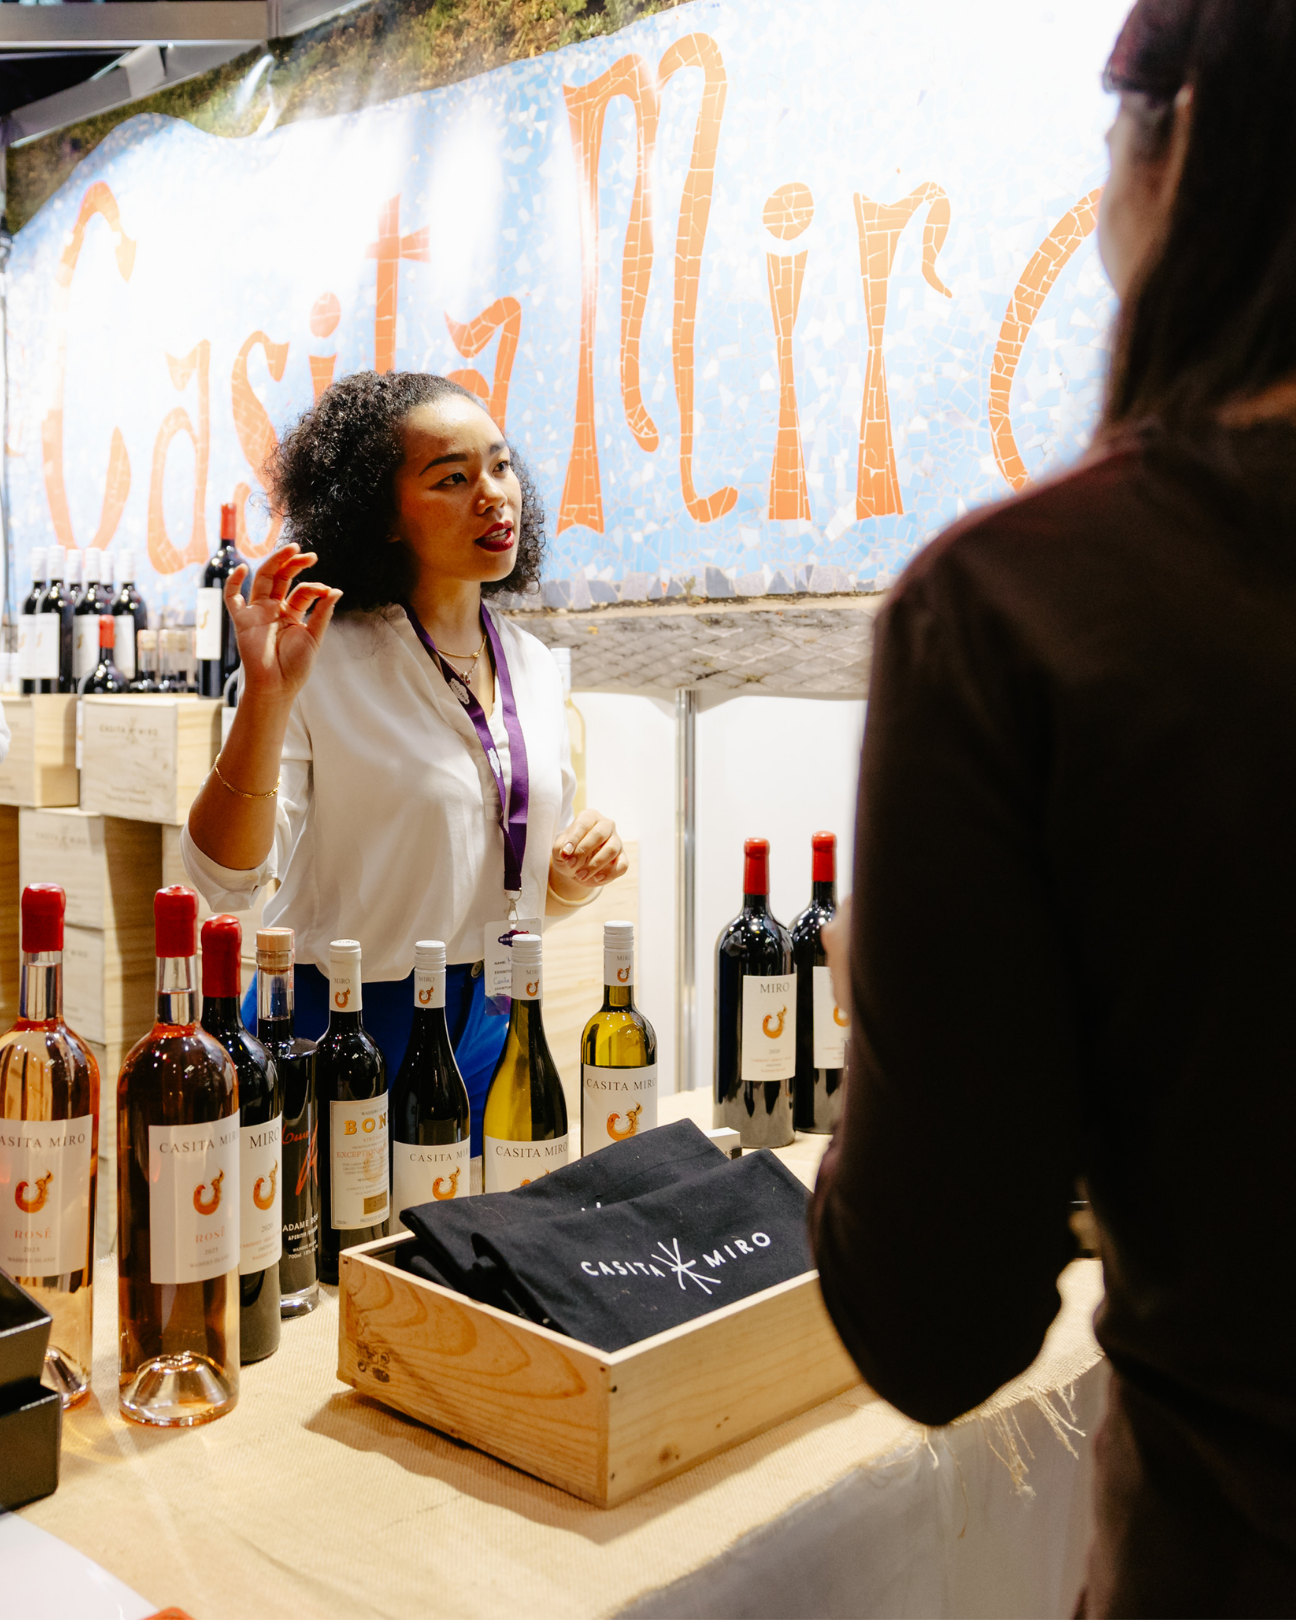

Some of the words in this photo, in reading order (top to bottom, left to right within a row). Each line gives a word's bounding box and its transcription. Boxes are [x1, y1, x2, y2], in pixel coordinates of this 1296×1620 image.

[418, 975, 436, 983] MIRO
[760, 982, 790, 993] MIRO
[586, 1078, 629, 1091] CASITA
[633, 1076, 658, 1090] MIRO
[49, 1133, 86, 1148] MIRO
[249, 1126, 280, 1150] MIRO
[159, 1139, 215, 1154] CASITA
[495, 1145, 542, 1158] CASITA
[544, 1141, 568, 1157] MIRO
[409, 1152, 453, 1163] CASITA
[14, 1227, 52, 1239] ROSÉ
[195, 1225, 226, 1244] ROSÉ
[580, 1260, 666, 1278] CASITA
[702, 1231, 772, 1268] MIRO
